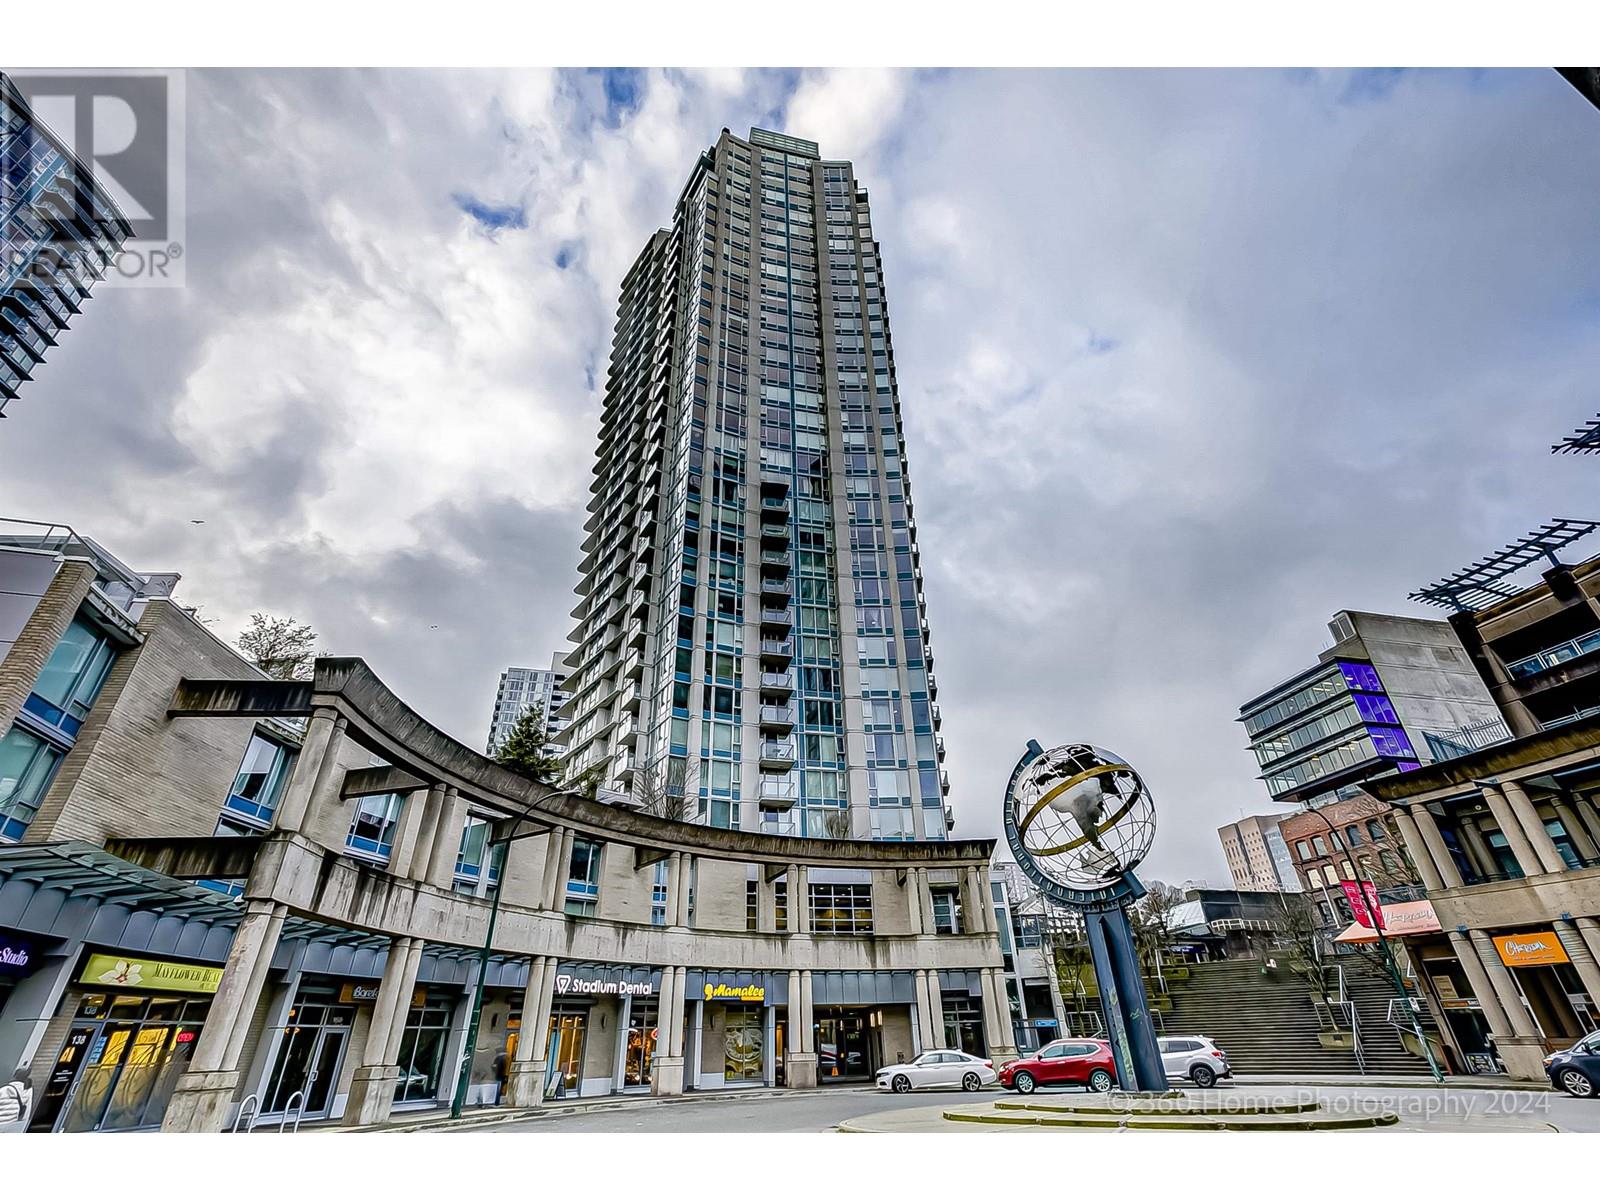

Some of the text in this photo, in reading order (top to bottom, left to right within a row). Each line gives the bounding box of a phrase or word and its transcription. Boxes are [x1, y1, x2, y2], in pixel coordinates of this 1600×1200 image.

[3, 947, 28, 966] Studio
[152, 963, 202, 981] MAYFLOWER
[572, 978, 652, 995] Stadium Dental
[71, 1035, 87, 1045] 138
